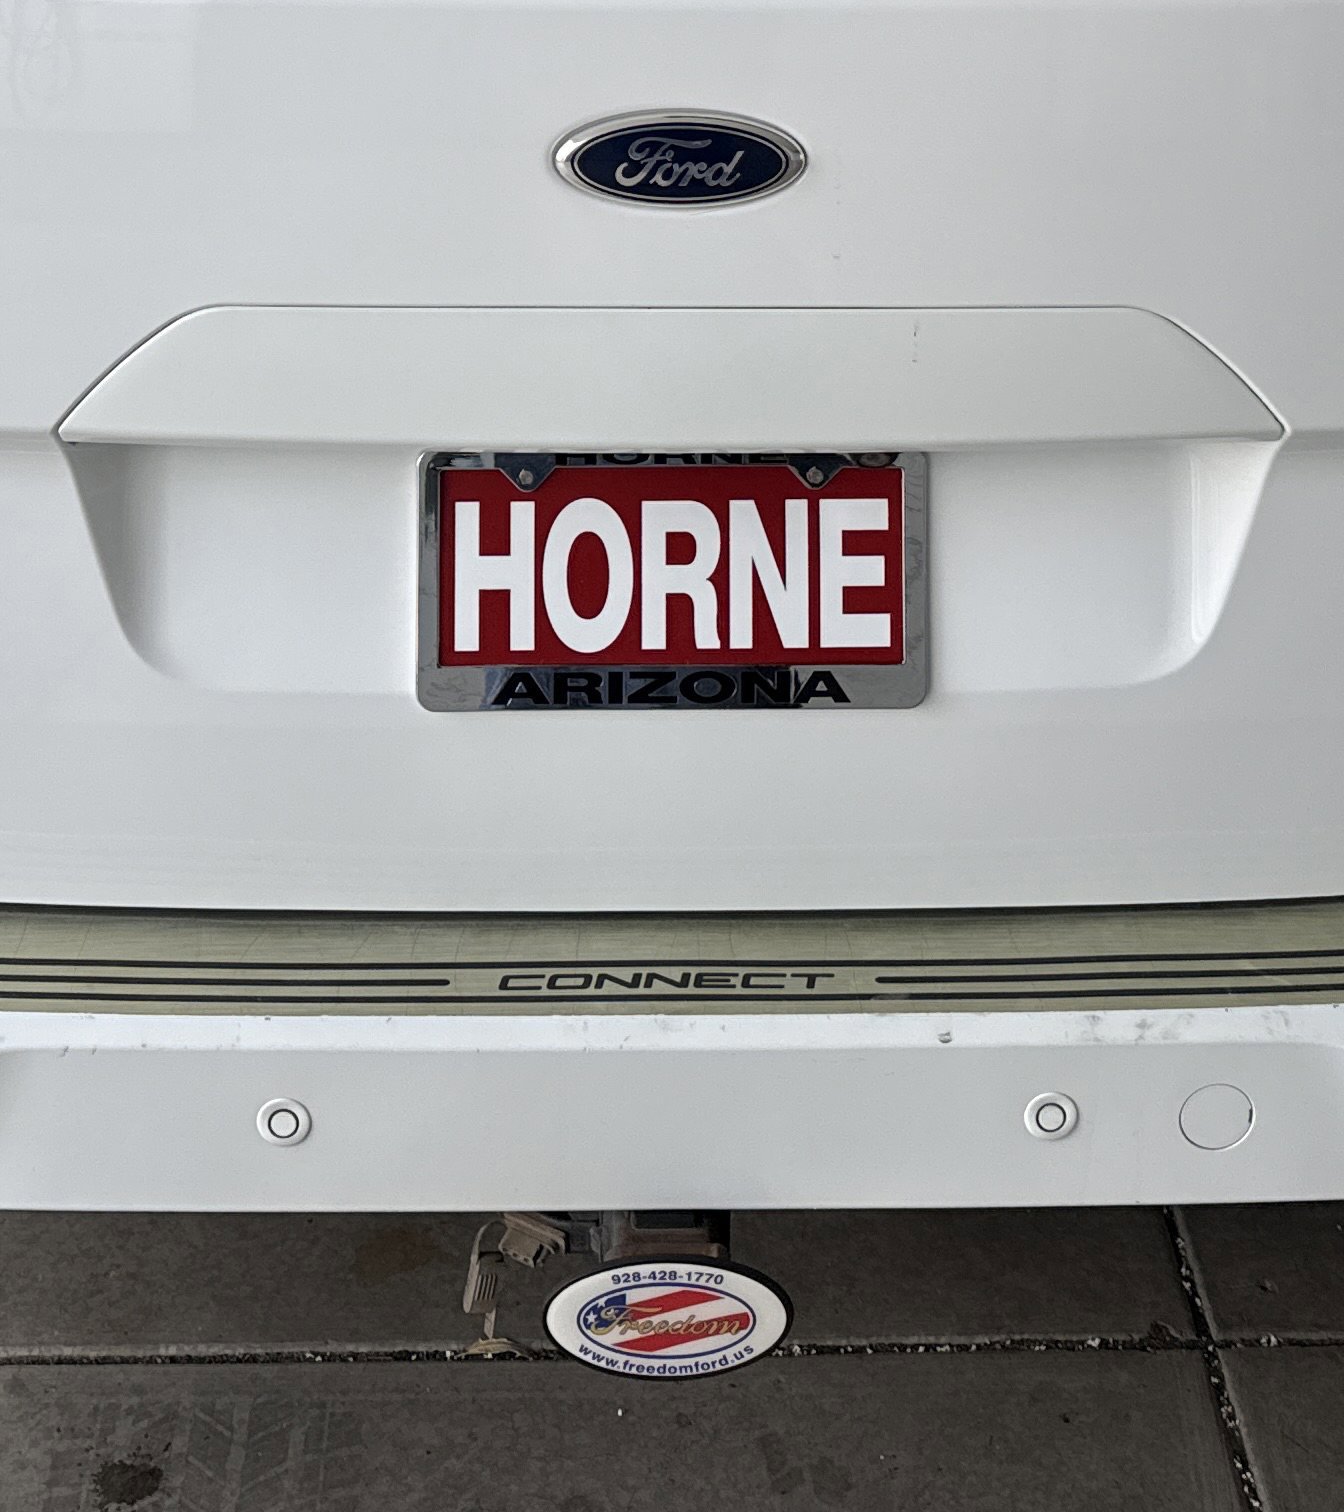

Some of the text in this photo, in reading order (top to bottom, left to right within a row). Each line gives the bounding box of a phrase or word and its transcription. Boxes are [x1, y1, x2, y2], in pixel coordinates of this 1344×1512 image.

[615, 137, 745, 187] Ford
[454, 497, 891, 654] HORNE
[491, 670, 852, 706] ARIZONA
[498, 972, 835, 991] CONNECT
[611, 1270, 724, 1286] 928-428-1770
[589, 1304, 742, 1336] Freedom
[578, 1343, 755, 1376] www.freedomford.us
